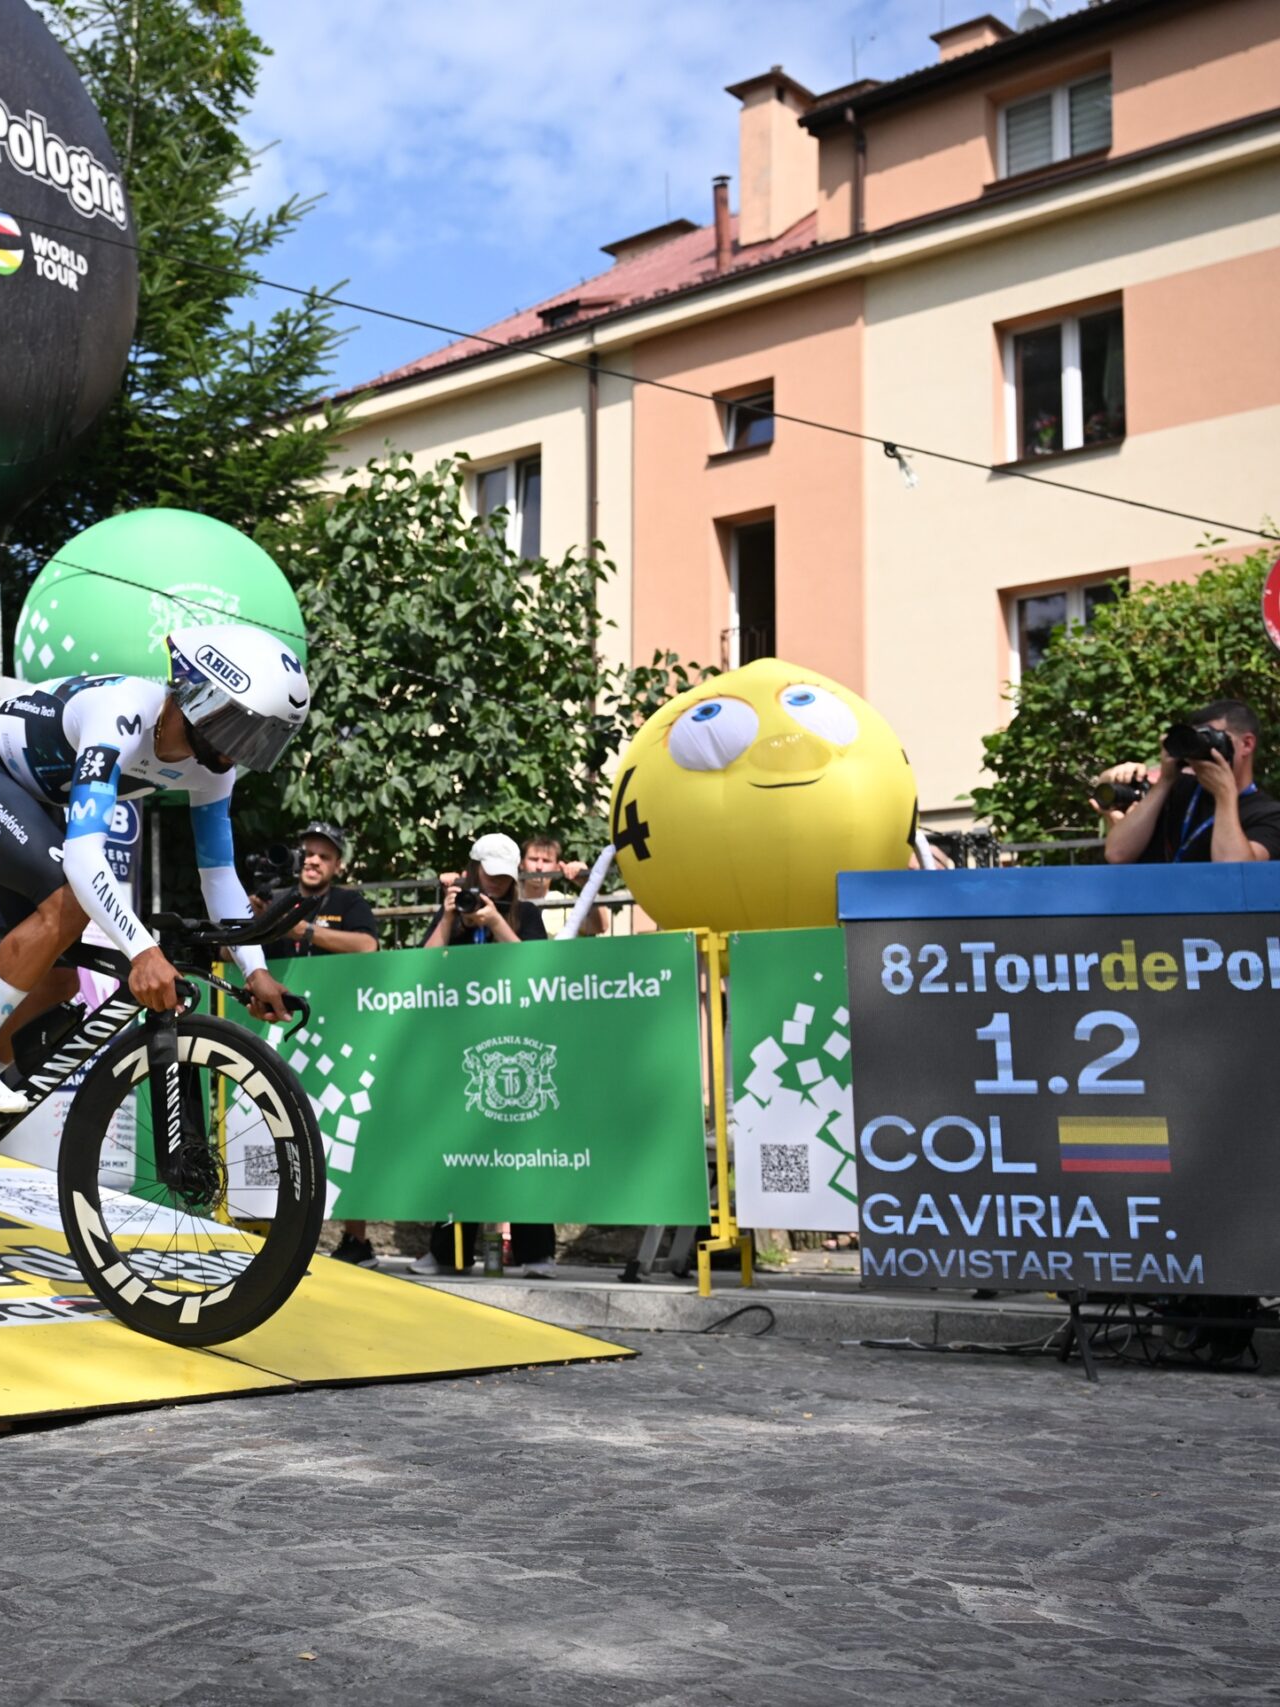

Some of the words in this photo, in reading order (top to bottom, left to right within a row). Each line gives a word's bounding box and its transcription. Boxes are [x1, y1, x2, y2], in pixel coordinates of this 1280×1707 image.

[30, 232, 88, 276] WORLD
[34, 256, 79, 291] TOUR
[200, 650, 244, 688] ABUS
[40, 705, 56, 718] Tech
[91, 870, 137, 941] CANYON
[356, 982, 459, 1015] Kopalnia
[465, 978, 513, 1006] Soli
[519, 969, 672, 1009] „Wieliczka”
[475, 1036, 521, 1053] KOPALNIA
[523, 1037, 545, 1051] SOLI
[974, 1009, 1146, 1095] 1.2
[166, 1061, 183, 1154] CANYON
[484, 1109, 540, 1122] WIELICZKA
[442, 1147, 591, 1172] www.kopalnia.pl
[860, 1114, 1038, 1174] COL
[289, 1141, 302, 1201] ZIPP
[861, 1192, 1110, 1240] GAVIRIA
[1125, 1195, 1178, 1241] F.
[861, 1246, 1074, 1281] MOVISTAR
[1084, 1250, 1205, 1284] TEAM
